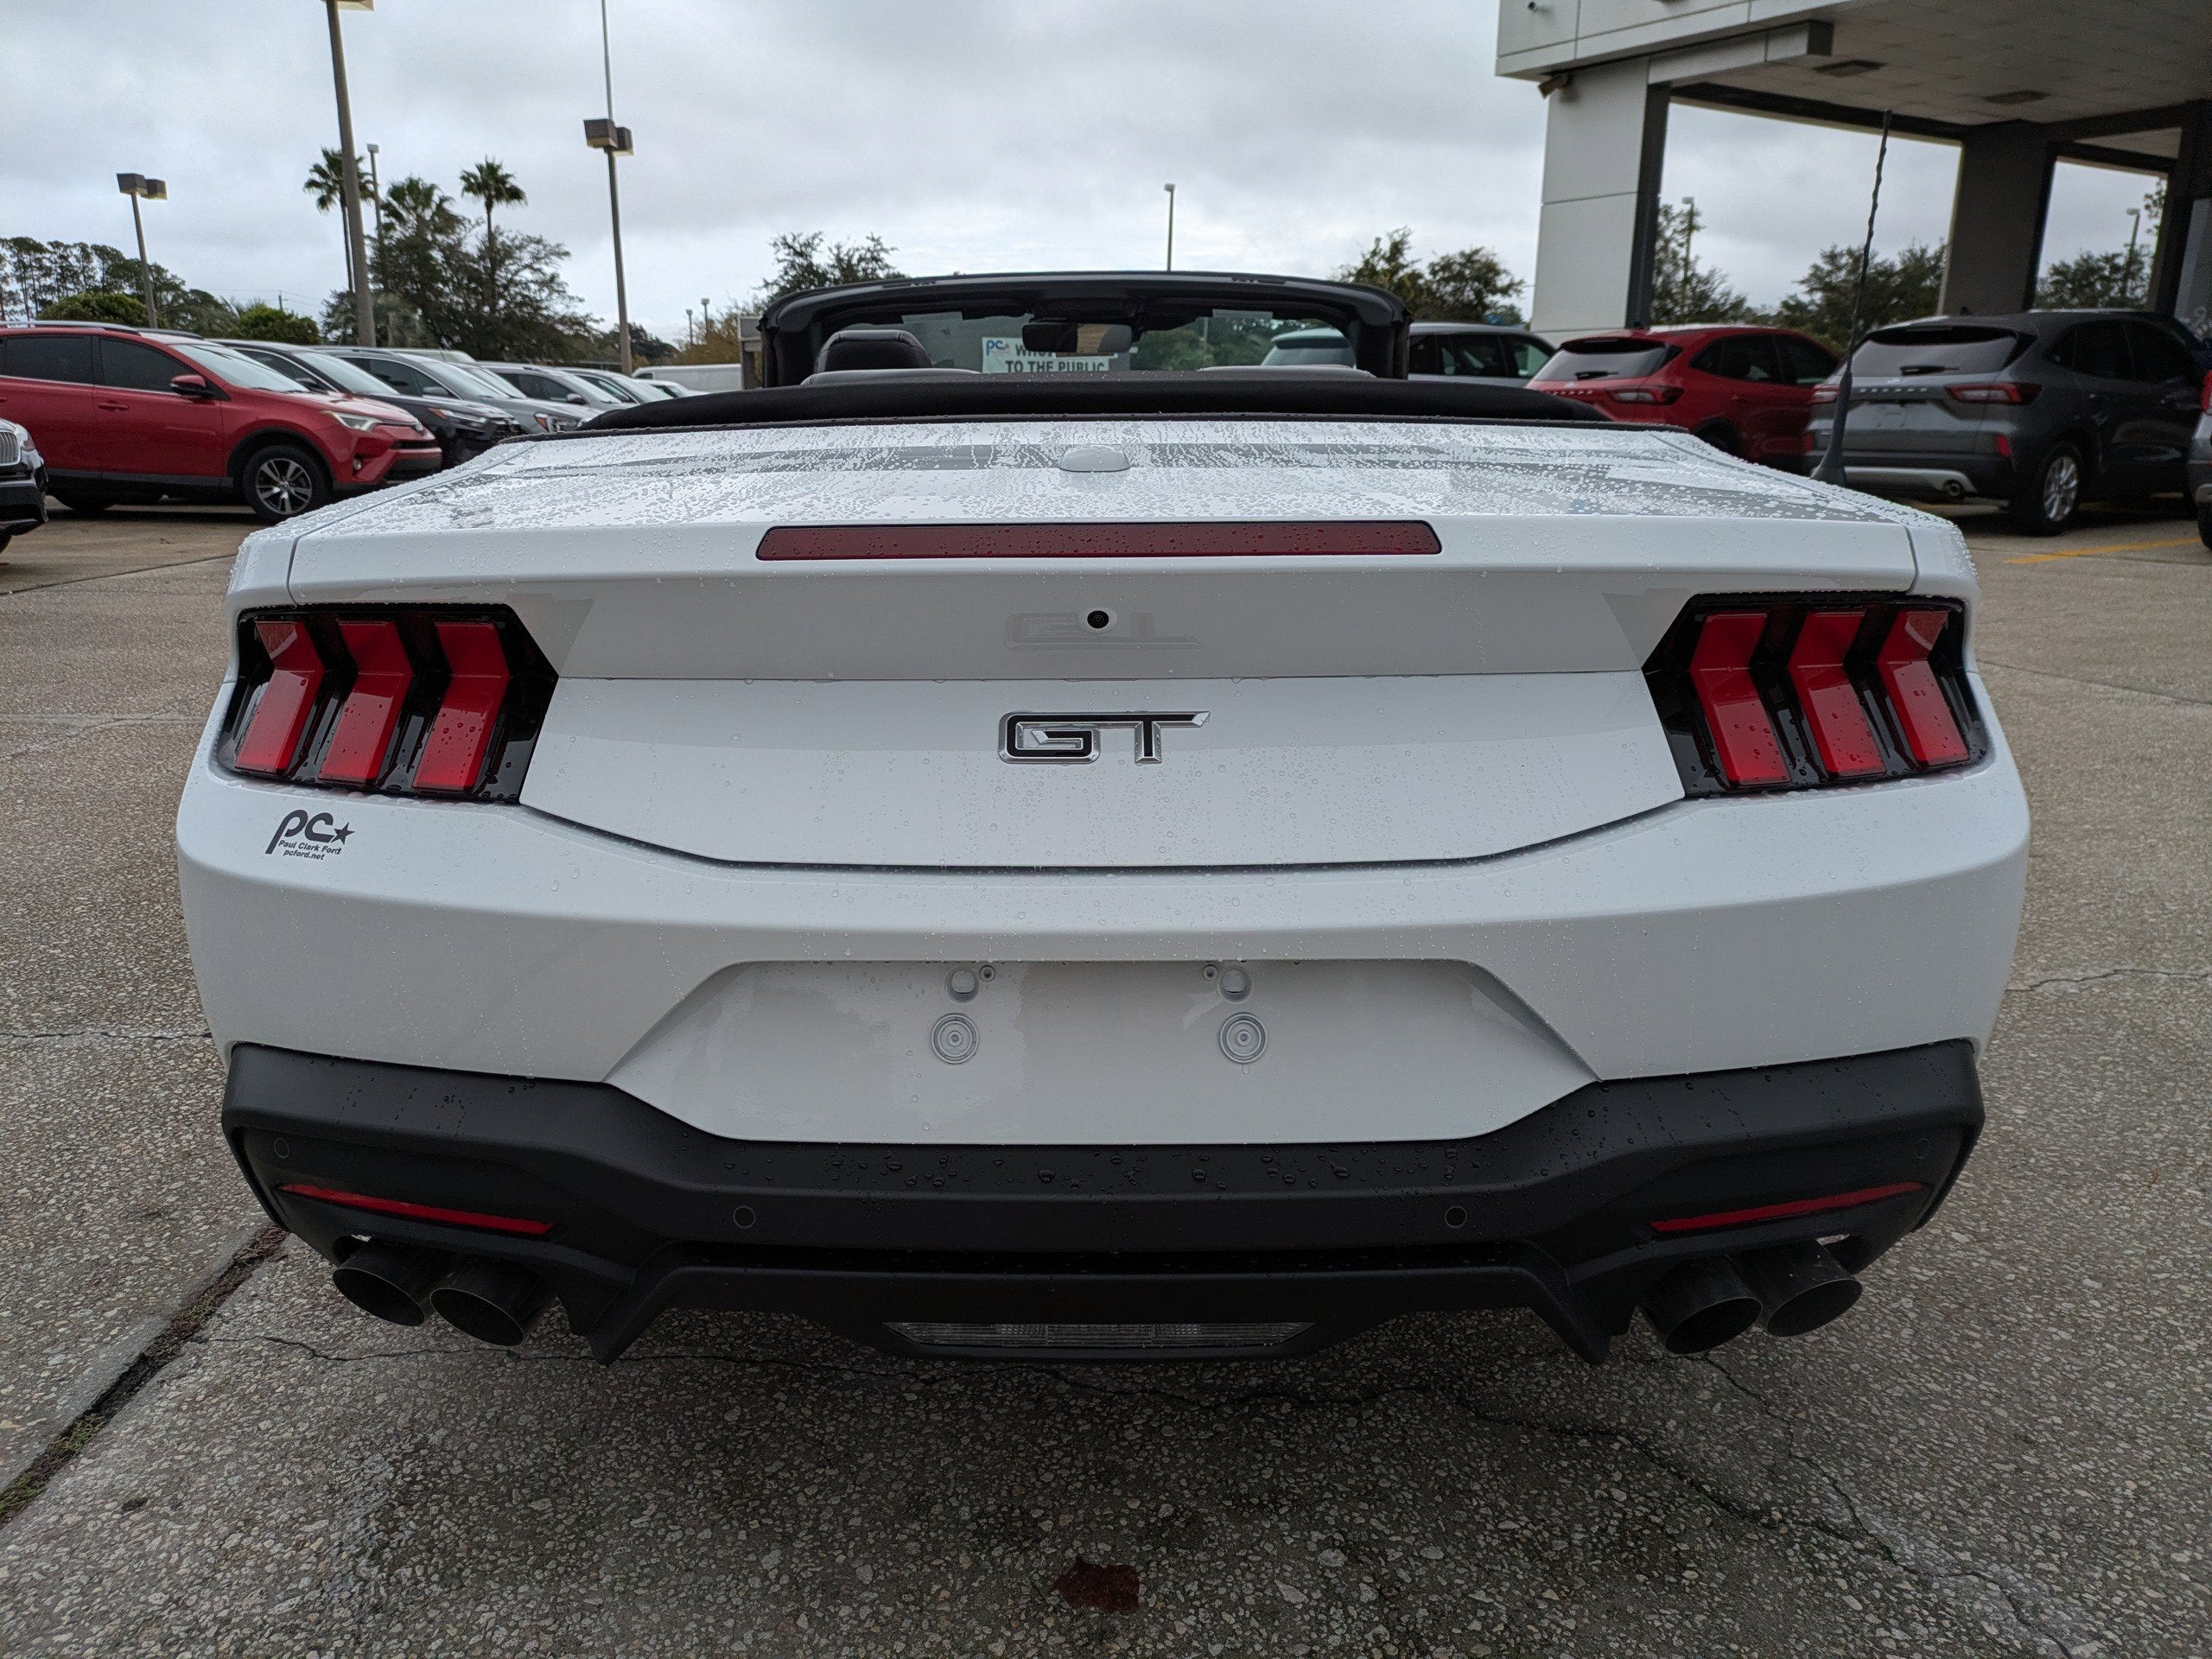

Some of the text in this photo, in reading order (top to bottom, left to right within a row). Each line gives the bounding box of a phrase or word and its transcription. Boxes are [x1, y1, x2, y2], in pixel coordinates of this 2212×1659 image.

[1006, 360, 1105, 372] TO THE PUBLIC
[998, 710, 1211, 765] GT
[278, 840, 342, 855] Paul Clark Ford
[283, 849, 325, 861] pcford.net
